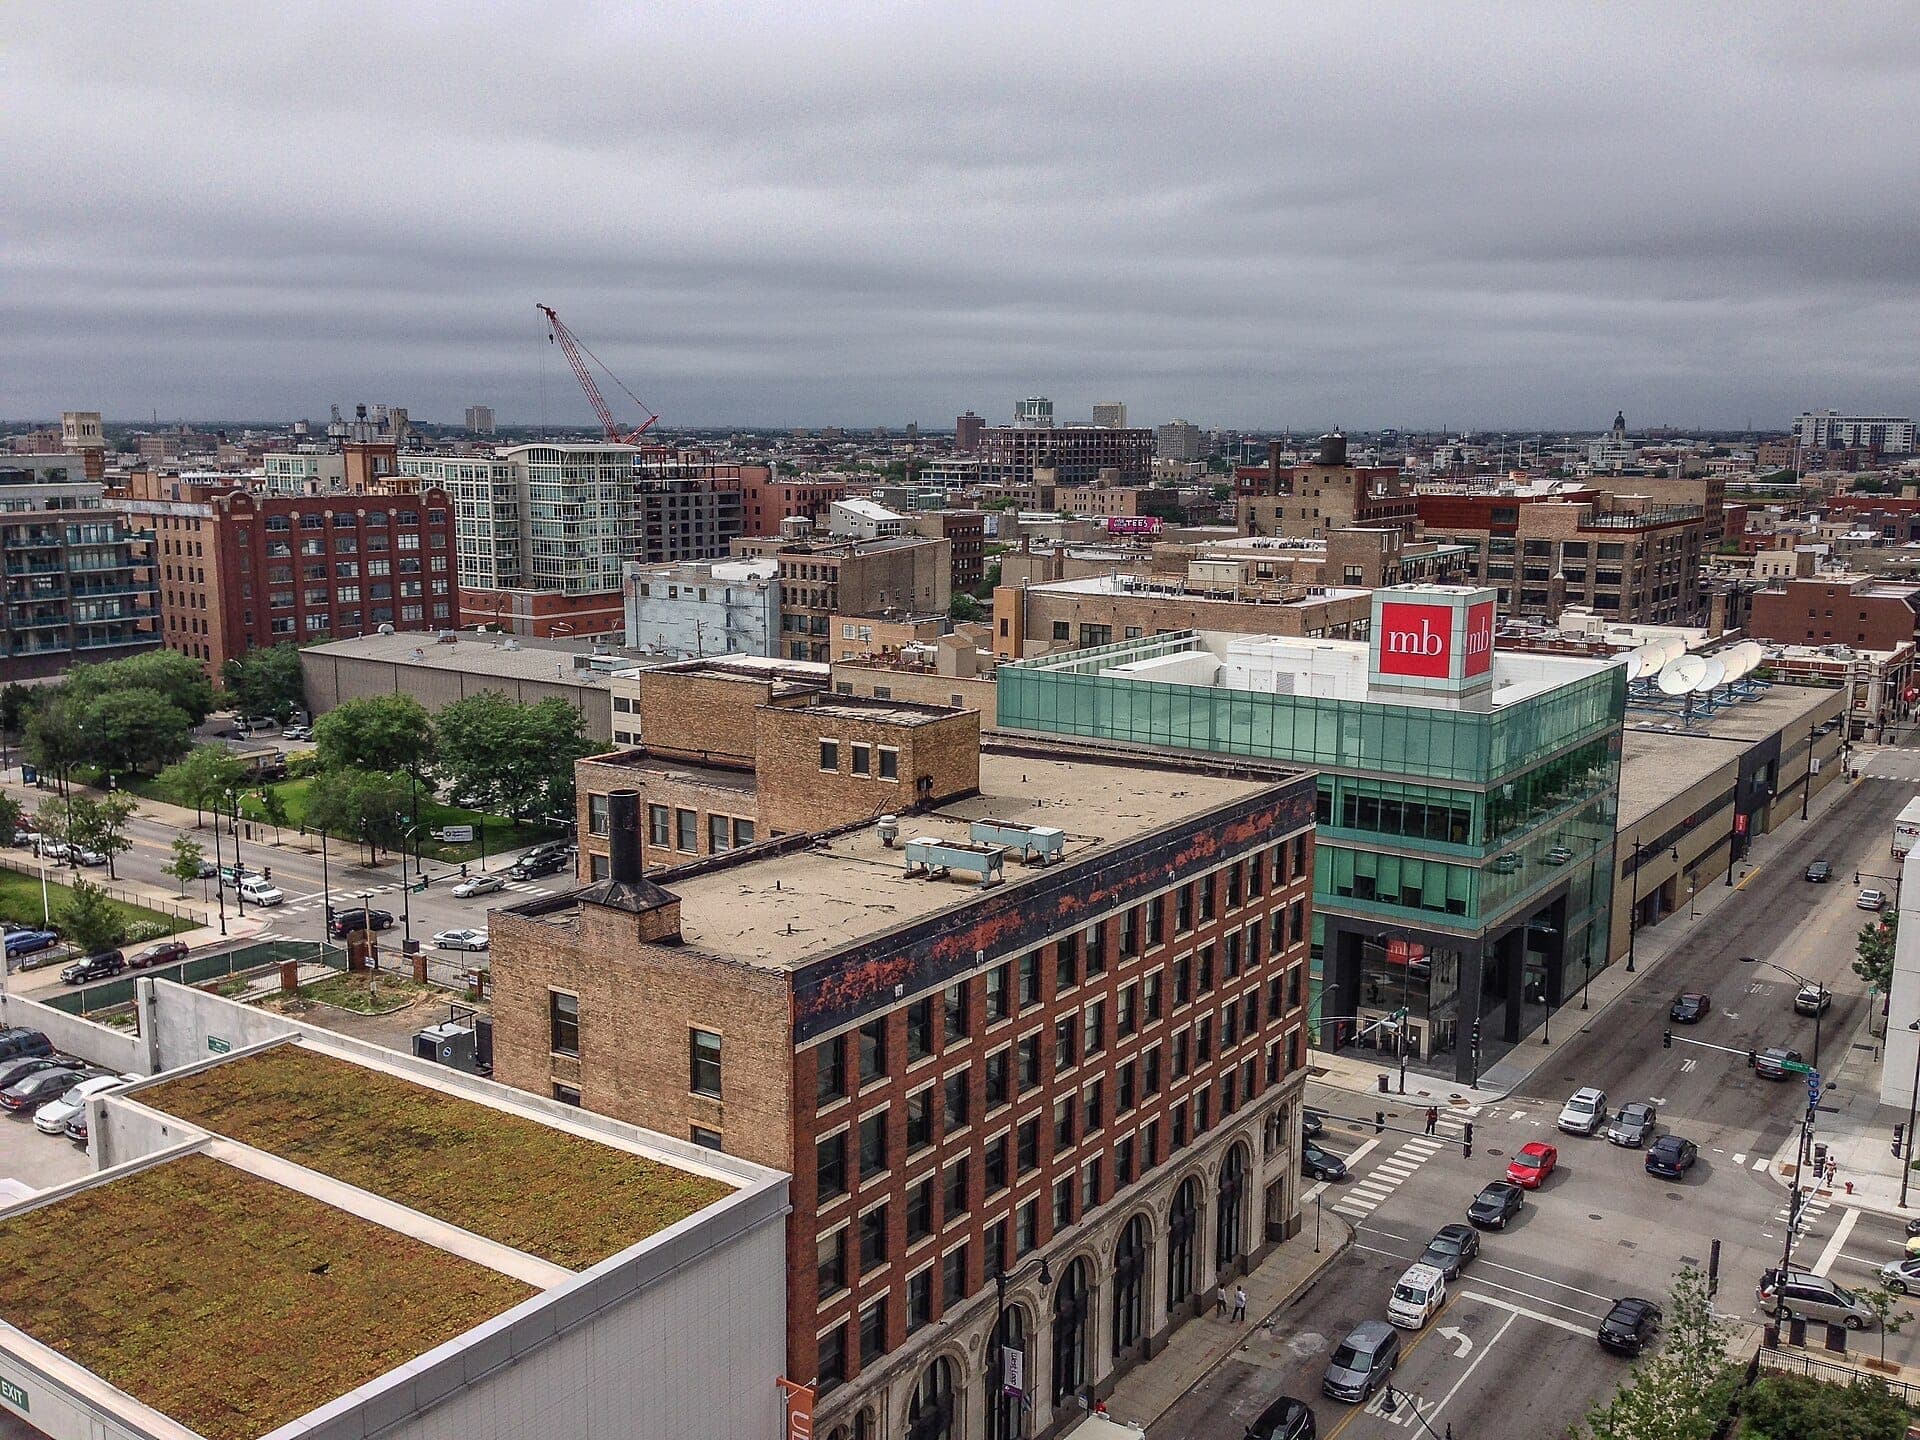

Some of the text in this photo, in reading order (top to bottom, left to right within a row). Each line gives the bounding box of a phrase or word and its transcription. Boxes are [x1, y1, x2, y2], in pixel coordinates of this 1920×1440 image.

[872, 490, 884, 498] cta
[1126, 519, 1148, 528] TEES
[1388, 619, 1443, 656] mb
[1469, 616, 1489, 655] mb
[1, 1381, 23, 1404] EXIT
